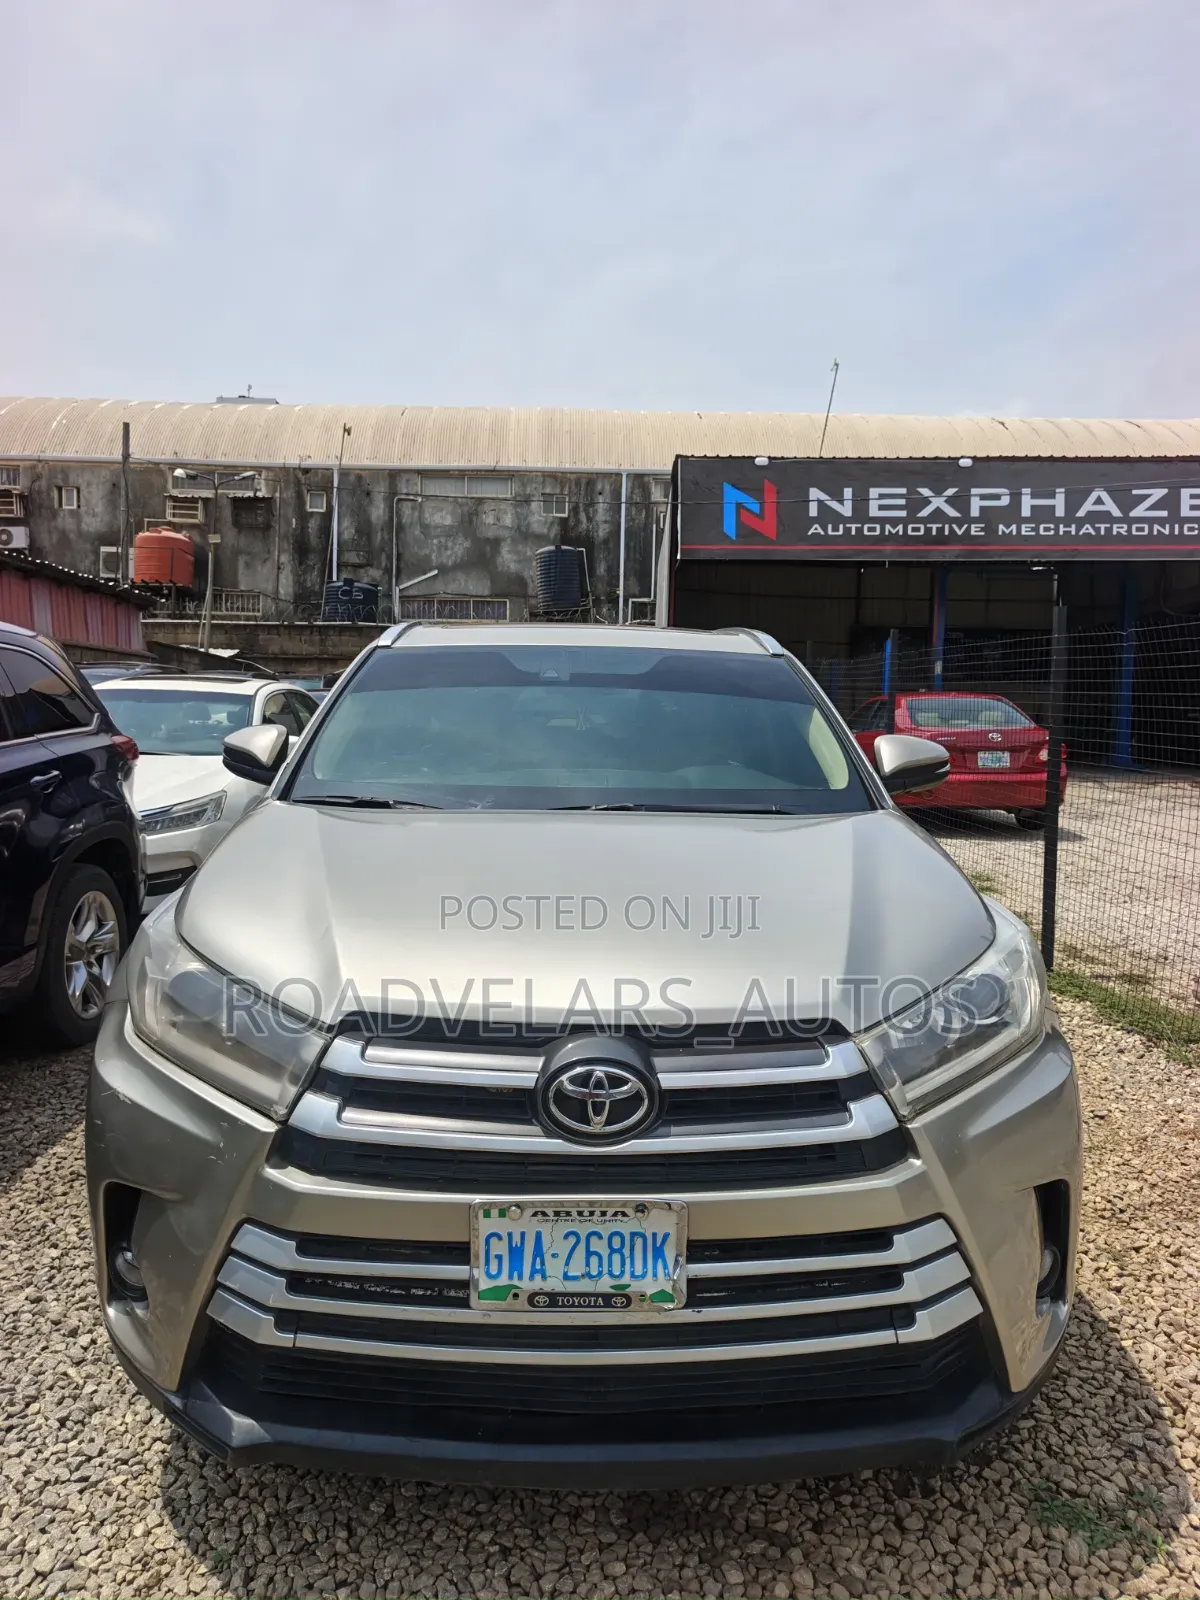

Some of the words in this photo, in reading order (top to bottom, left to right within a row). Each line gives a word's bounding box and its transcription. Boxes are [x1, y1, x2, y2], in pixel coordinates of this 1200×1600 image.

[808, 487, 1200, 518] NEXPHAZE
[807, 523, 985, 536] AUTOMOTIVE
[998, 523, 1199, 536] MECHATRONIC
[530, 1210, 630, 1218] ABUJA
[484, 1230, 671, 1282] GWA-268DK
[556, 1296, 604, 1306] TOYOTA
